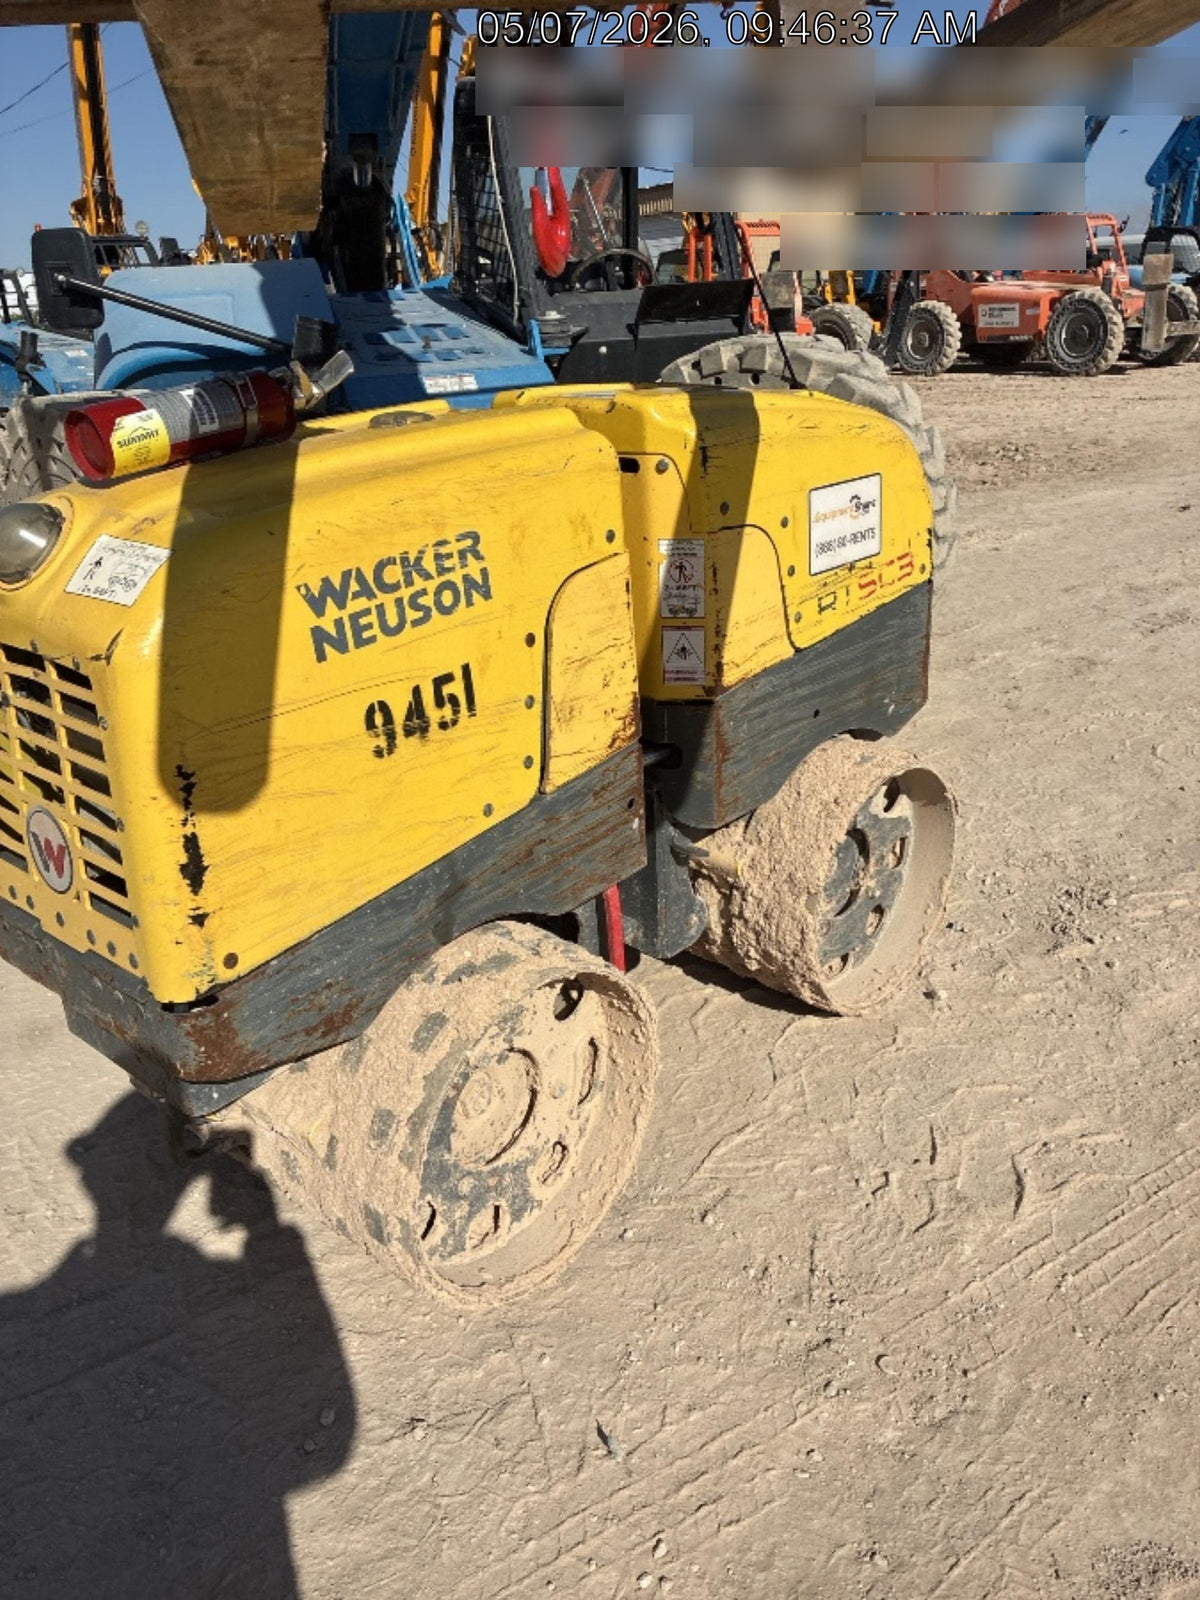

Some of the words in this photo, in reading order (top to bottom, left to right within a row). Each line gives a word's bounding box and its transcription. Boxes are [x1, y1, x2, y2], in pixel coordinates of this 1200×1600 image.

[295, 530, 485, 618] WACKER
[310, 567, 493, 663] NEUSON
[364, 662, 477, 759] 9451
